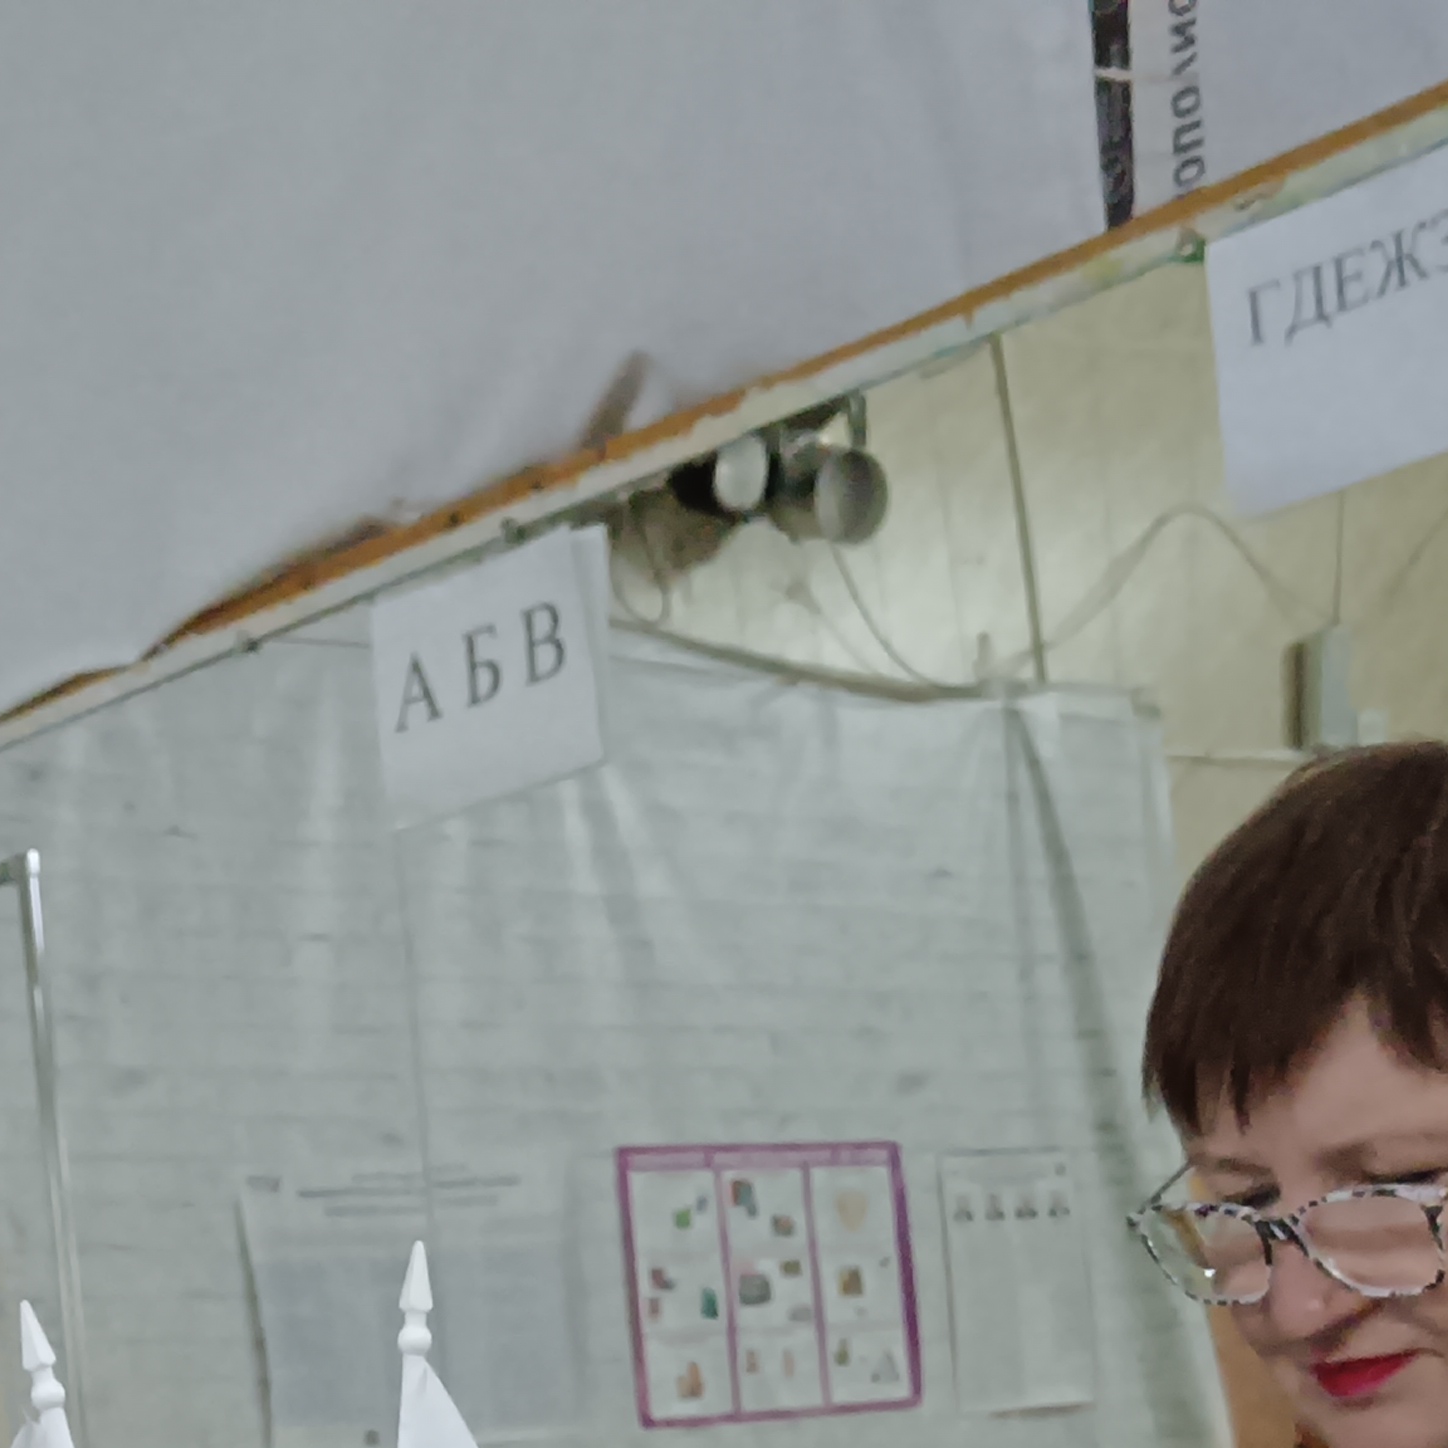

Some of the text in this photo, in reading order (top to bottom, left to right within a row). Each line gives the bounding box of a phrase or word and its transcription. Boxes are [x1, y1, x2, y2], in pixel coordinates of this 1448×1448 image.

[394, 602, 566, 733] А Б В
